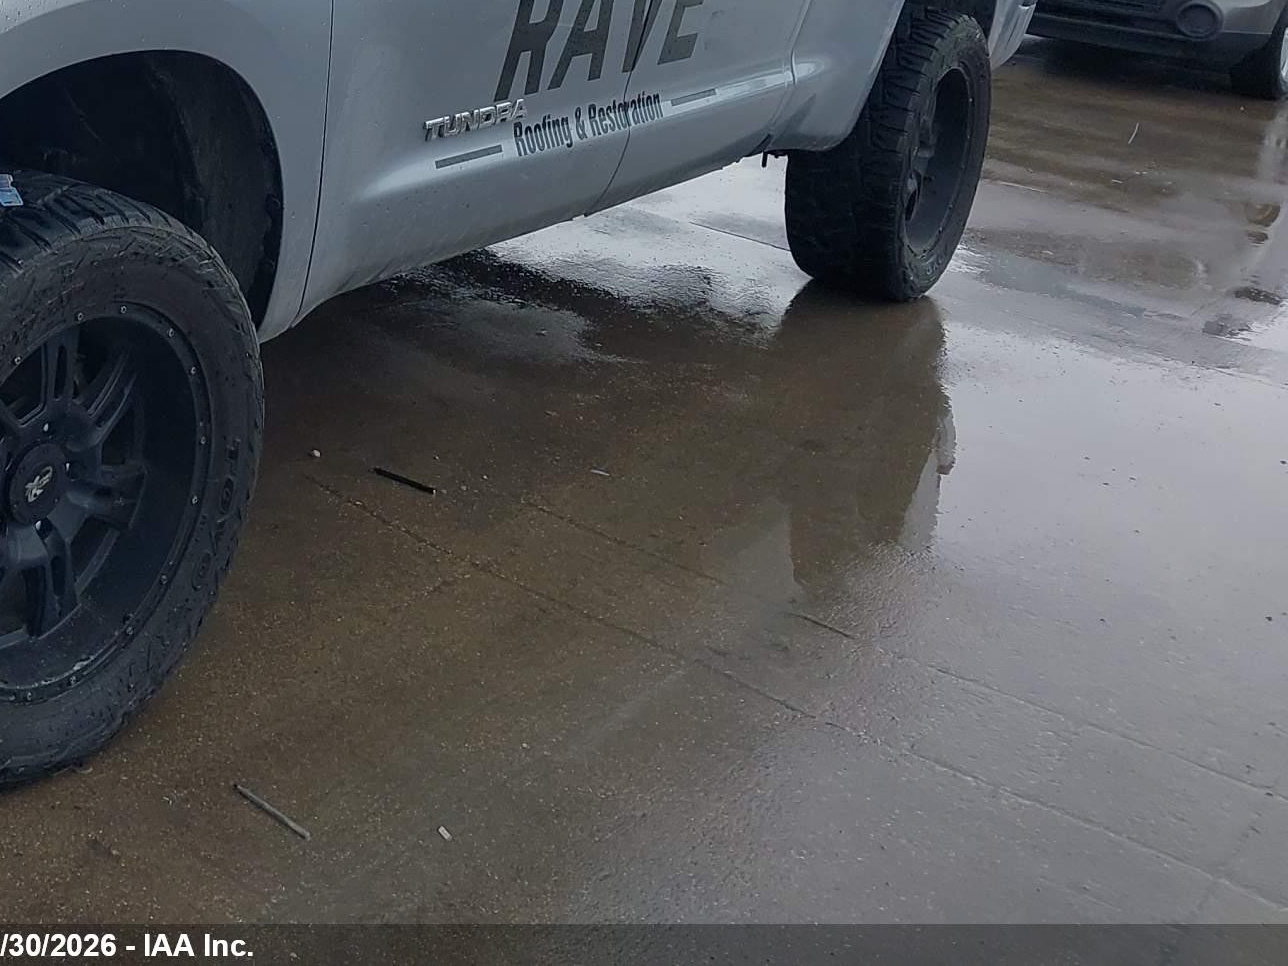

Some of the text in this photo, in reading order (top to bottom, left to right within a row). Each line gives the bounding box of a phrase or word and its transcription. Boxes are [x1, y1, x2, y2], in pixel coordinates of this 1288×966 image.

[423, 98, 528, 141] TUNDRA
[513, 90, 665, 157] Roofing & Restoration
